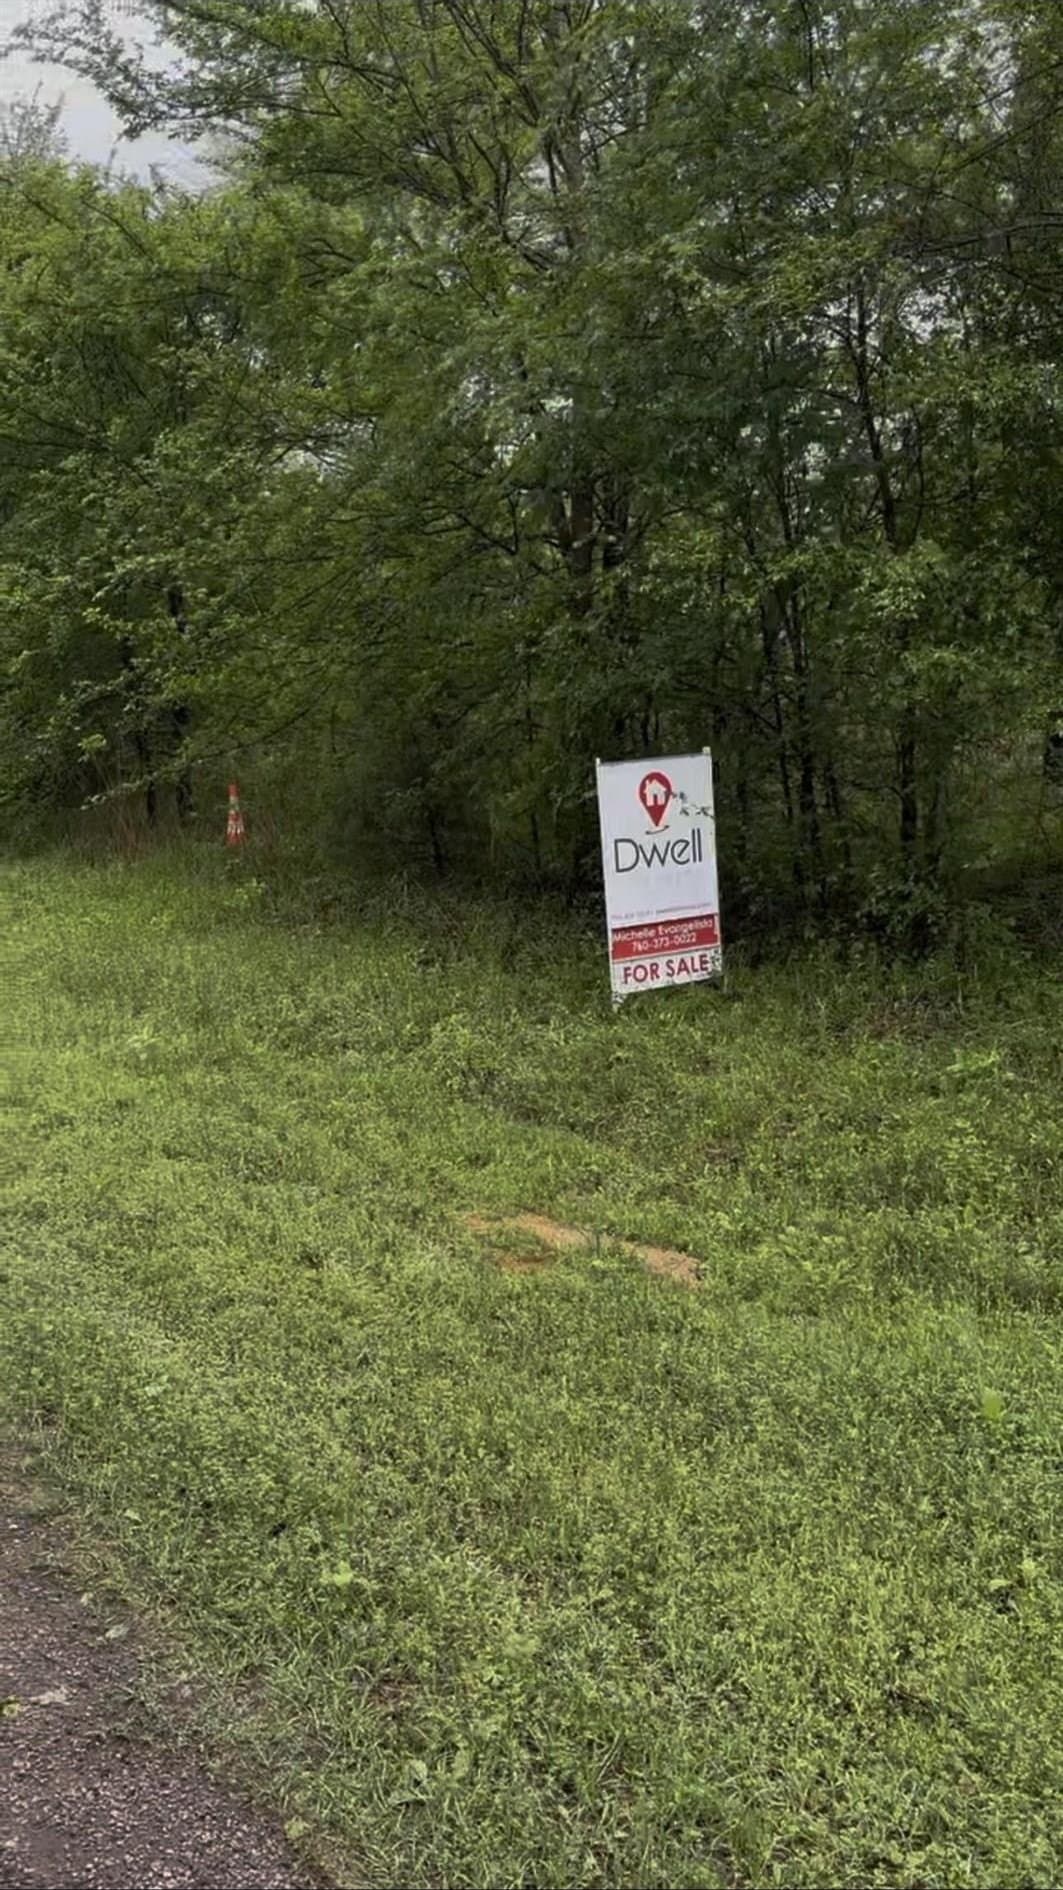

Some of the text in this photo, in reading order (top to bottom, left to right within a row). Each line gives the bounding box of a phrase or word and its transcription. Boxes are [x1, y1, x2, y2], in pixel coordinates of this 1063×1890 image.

[614, 828, 702, 873] Dwell
[613, 927, 656, 942] Michelle
[623, 954, 710, 984] FOR SALE
